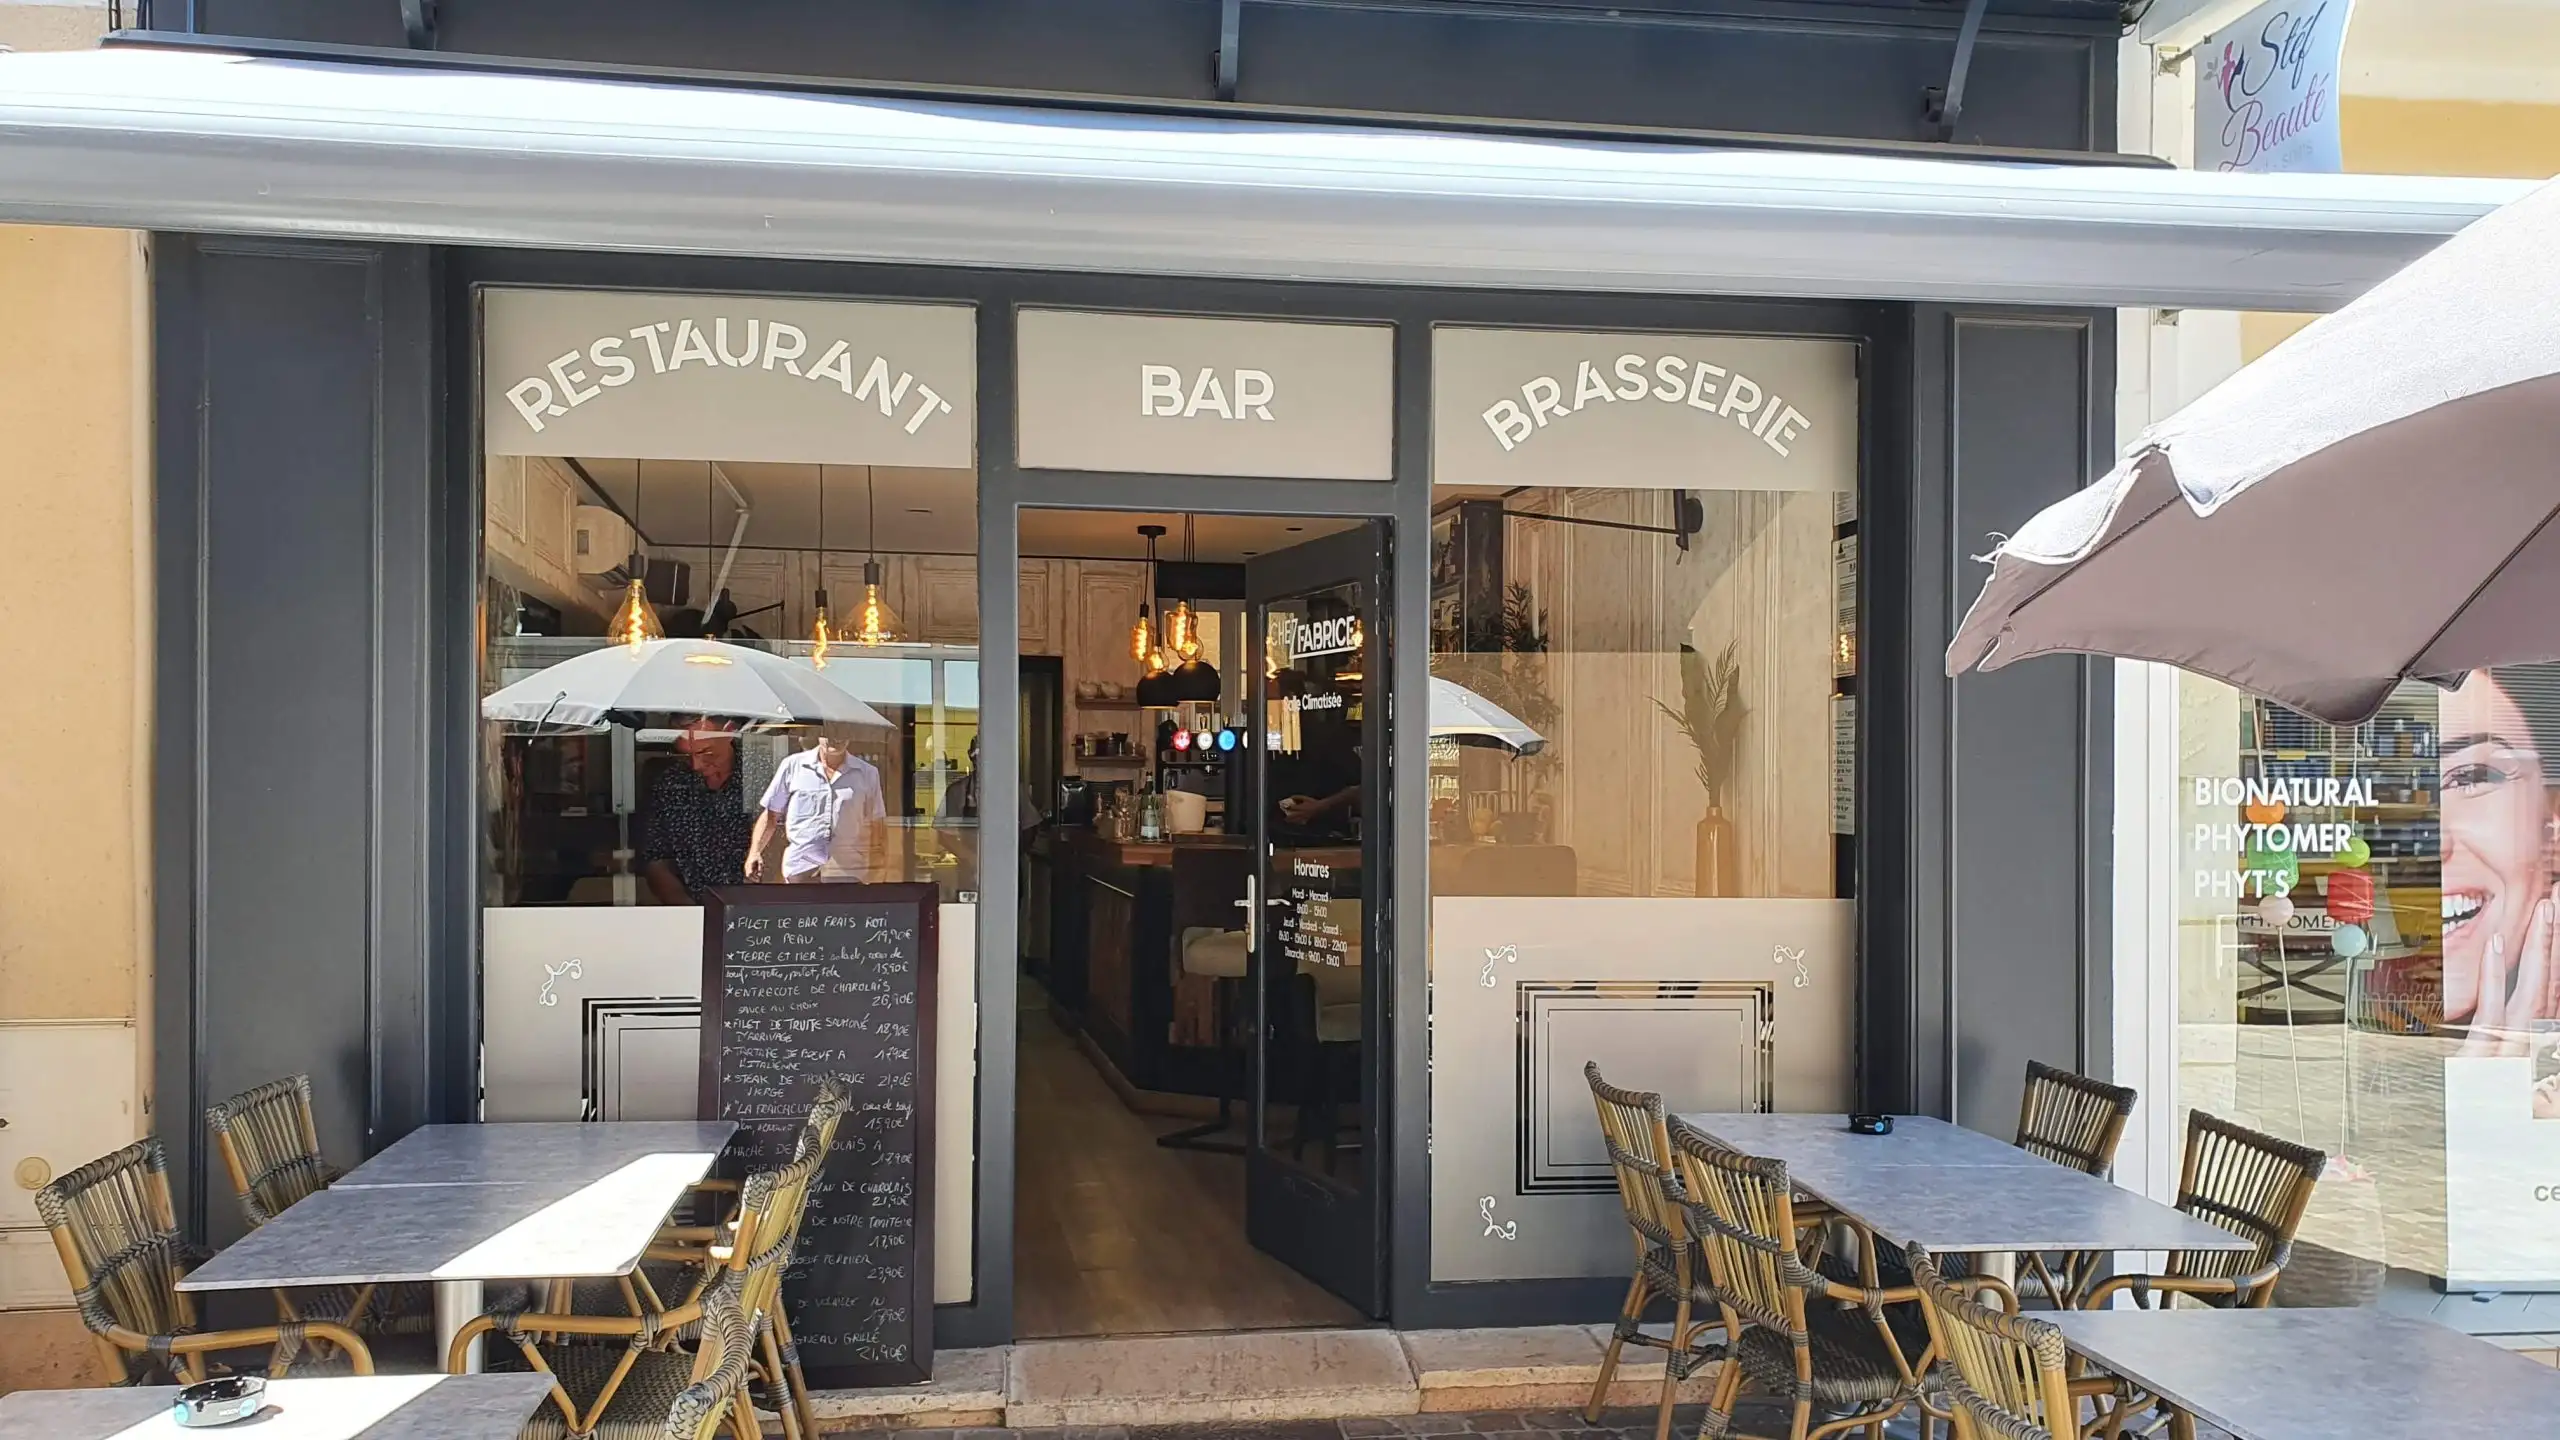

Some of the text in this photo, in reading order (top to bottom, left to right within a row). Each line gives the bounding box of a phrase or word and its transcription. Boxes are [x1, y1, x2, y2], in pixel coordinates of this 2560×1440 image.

[2219, 73, 2329, 172] Beauté
[505, 317, 952, 435] RESTAURANT
[1142, 364, 1276, 421] BAR
[1481, 353, 1812, 458] BRASSERIE
[1270, 615, 1355, 659] CHEZ FABRICE
[1302, 692, 1342, 710] Climatisée
[2195, 777, 2378, 807] BIONATURAL
[2194, 823, 2353, 853] PHYTOMER
[1294, 858, 1330, 878] Horaires
[2194, 869, 2290, 898] PHYT'S
[1291, 888, 1304, 899] Mardi
[737, 916, 769, 930] FILET
[777, 917, 791, 928] DE
[798, 917, 818, 928] BAR
[746, 936, 772, 947] SUR
[783, 933, 814, 945] PEAU
[777, 951, 791, 961] ET
[811, 985, 825, 994] DE
[735, 1074, 769, 1084] STEAK
[778, 1074, 793, 1085] DE
[842, 1181, 856, 1192] DE
[812, 1216, 827, 1226] DE
[833, 1214, 864, 1228] NOTRE
